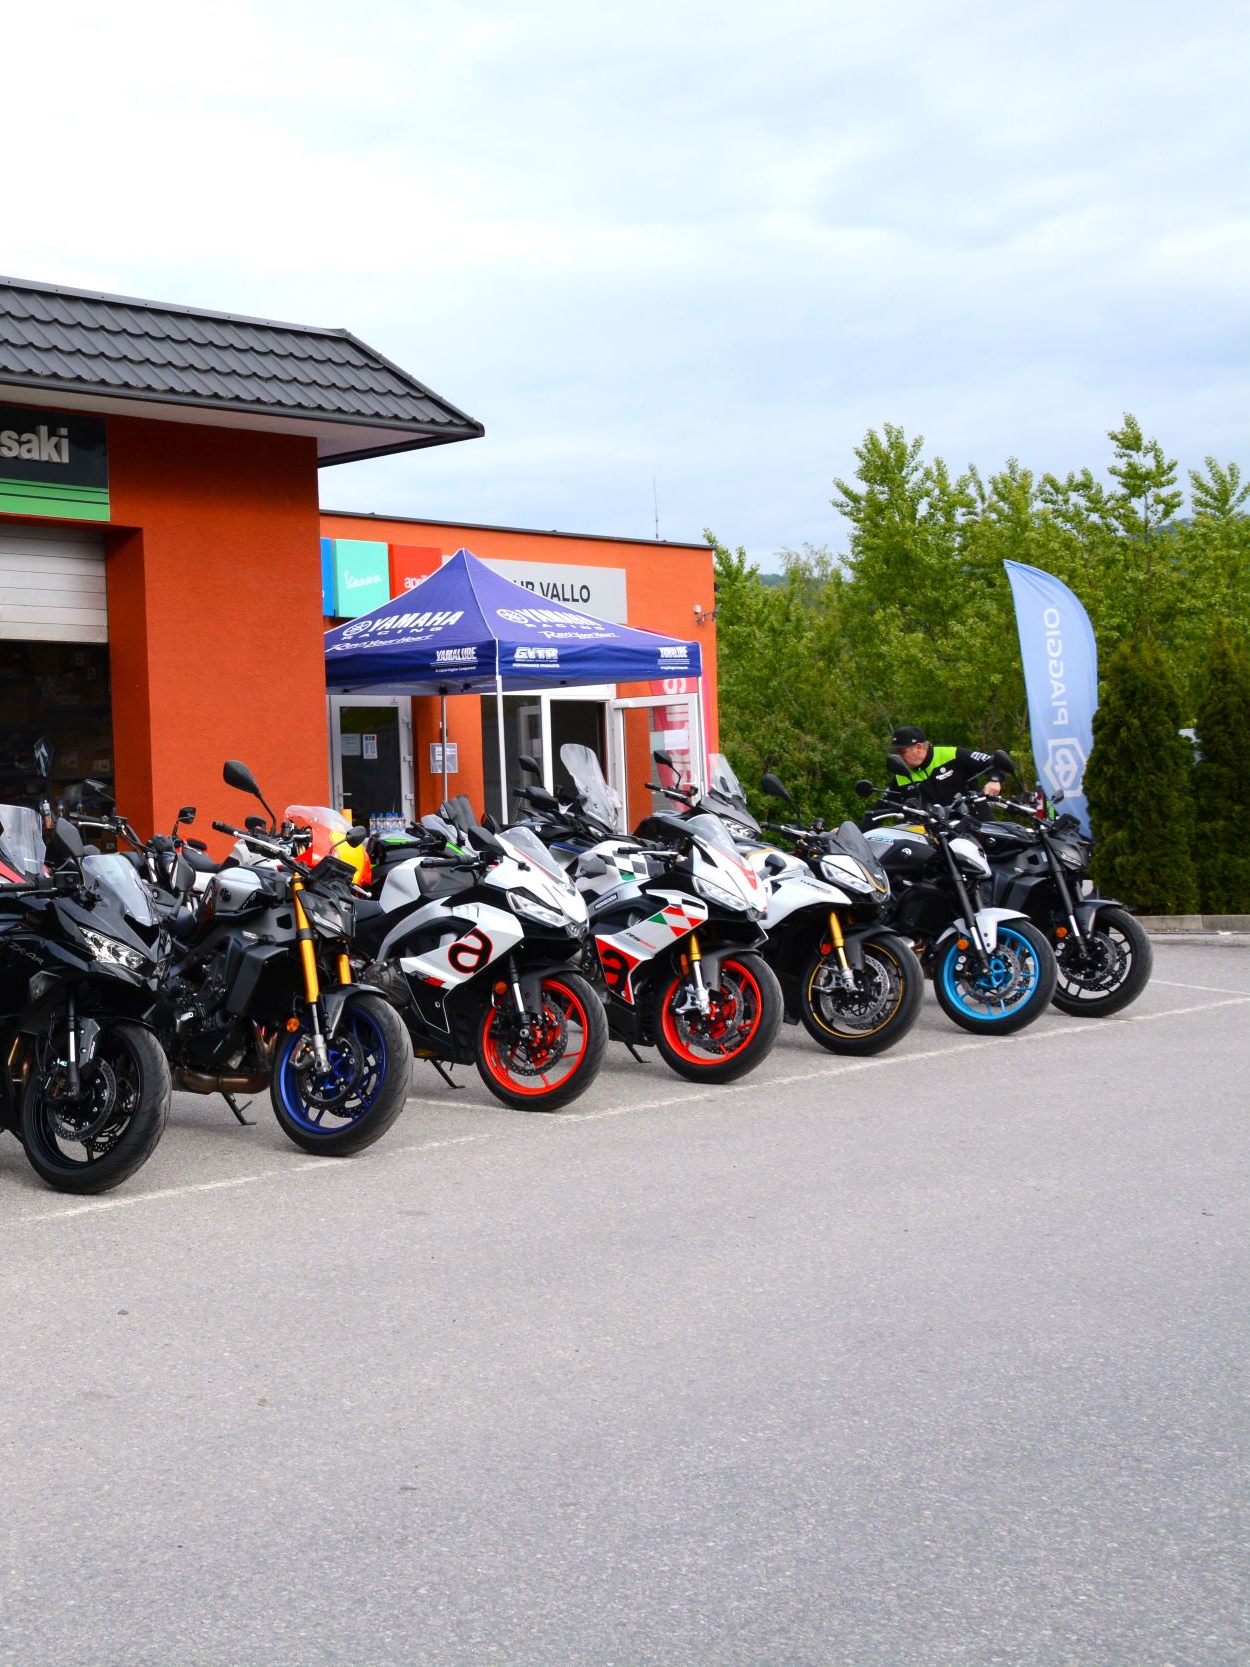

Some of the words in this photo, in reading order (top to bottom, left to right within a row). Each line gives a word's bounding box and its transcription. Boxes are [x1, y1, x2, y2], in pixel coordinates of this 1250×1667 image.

[344, 570, 382, 589] Vespa
[539, 581, 591, 603] VALLO
[368, 610, 465, 632] YAMAHA
[341, 626, 444, 640] RACING
[435, 647, 477, 661] YAMALUBE
